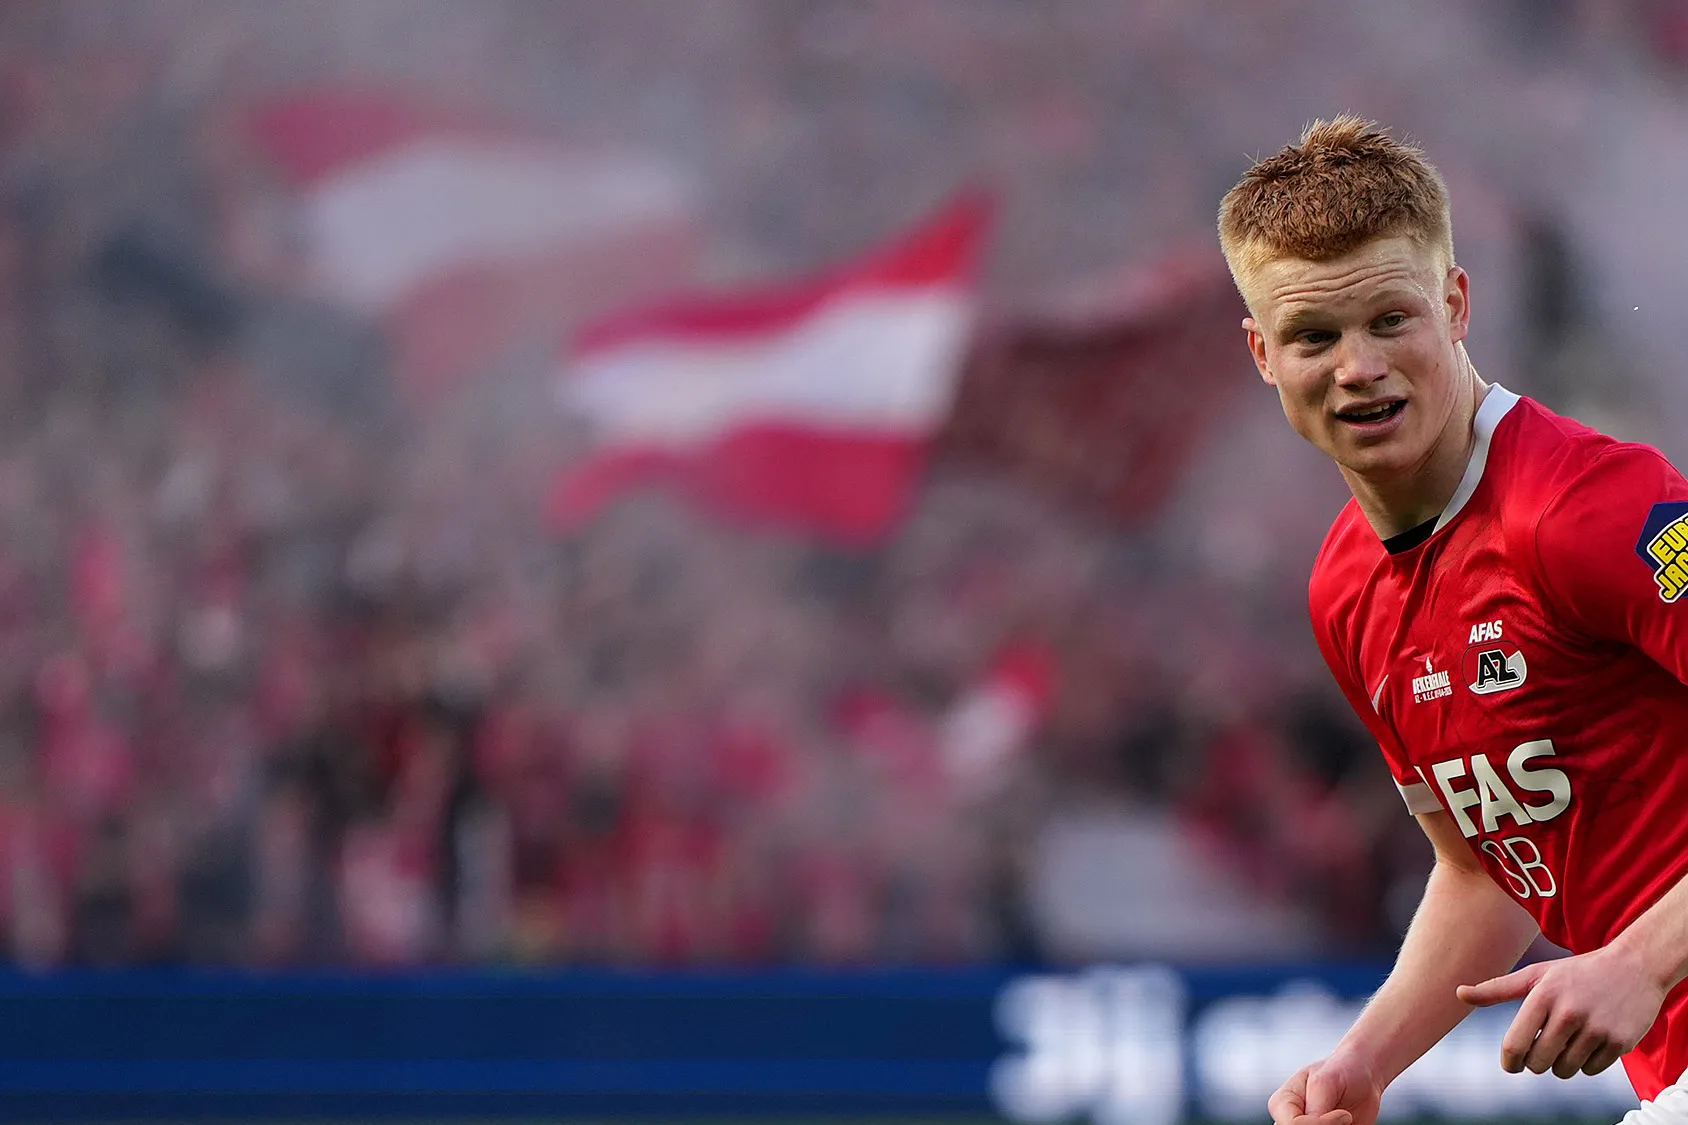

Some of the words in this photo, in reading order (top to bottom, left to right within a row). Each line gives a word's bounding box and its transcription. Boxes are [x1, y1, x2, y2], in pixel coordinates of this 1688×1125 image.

[1468, 619, 1503, 644] AFAS
[1476, 648, 1521, 689] AZ
[1414, 738, 1572, 839] FAS
[1480, 836, 1557, 899] SB
